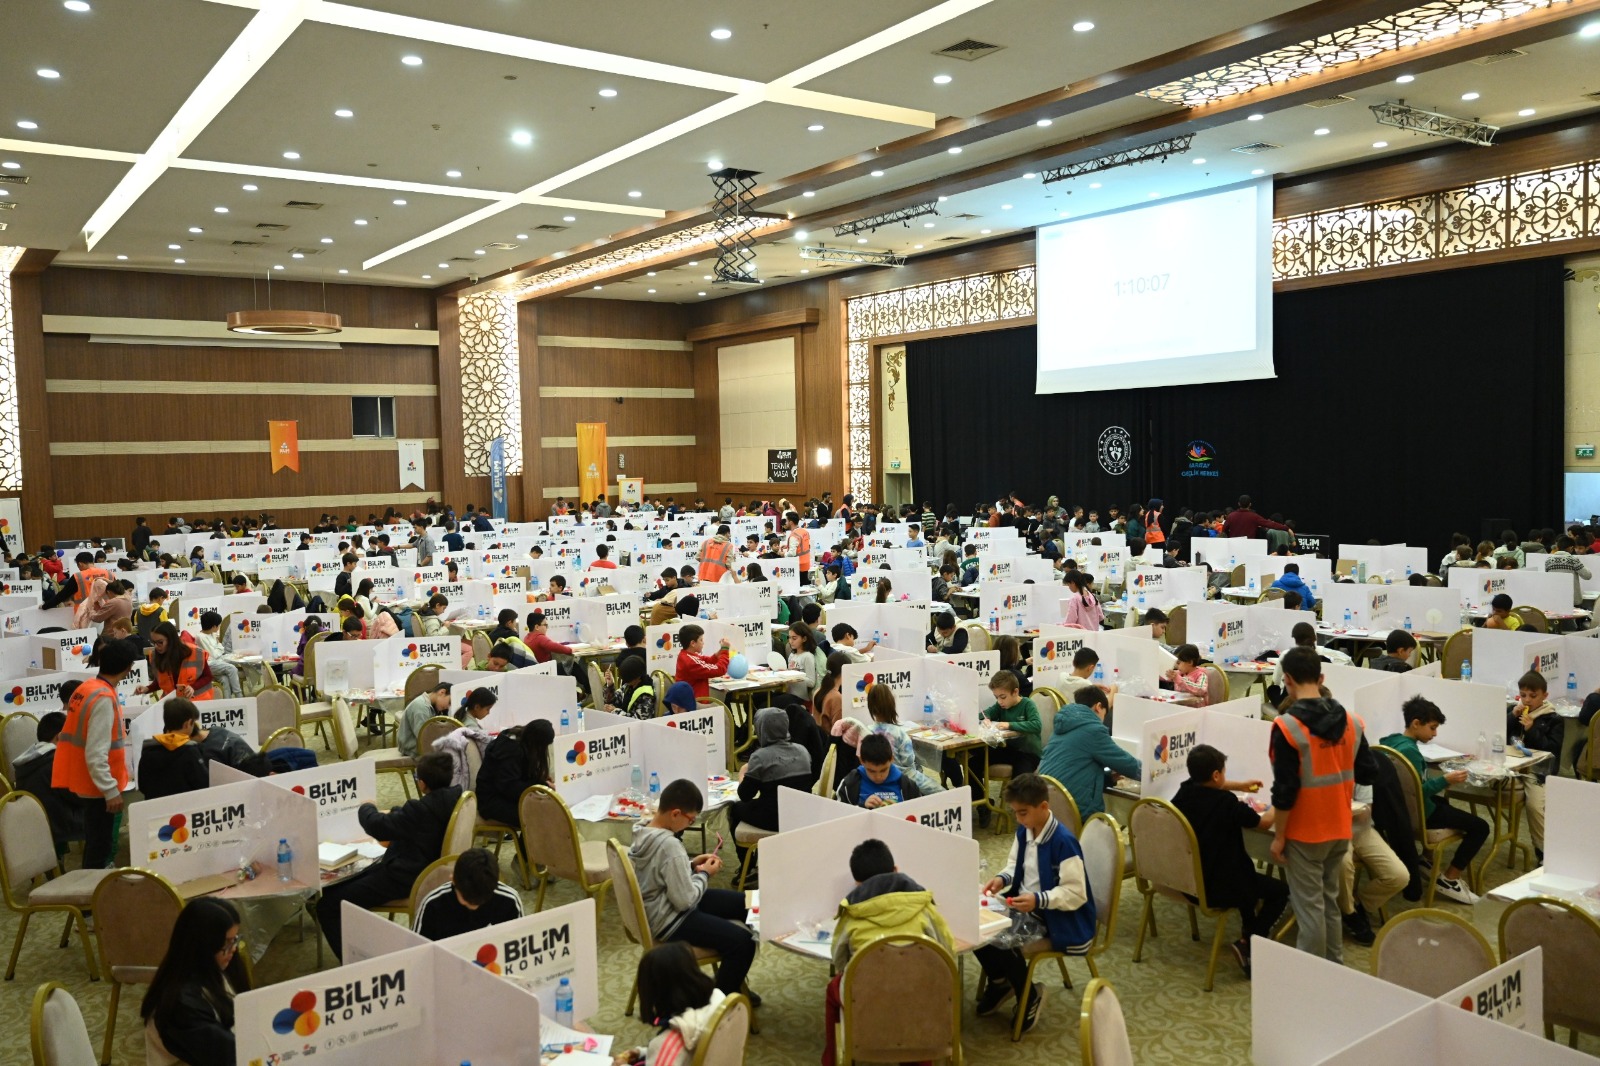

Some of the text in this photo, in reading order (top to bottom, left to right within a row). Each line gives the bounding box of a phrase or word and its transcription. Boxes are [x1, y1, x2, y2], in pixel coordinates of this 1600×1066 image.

[1114, 273, 1170, 296] 1:10:07
[771, 462, 790, 470] TEKNİK
[505, 948, 570, 976] KONYA
[325, 994, 406, 1026] KONYA
